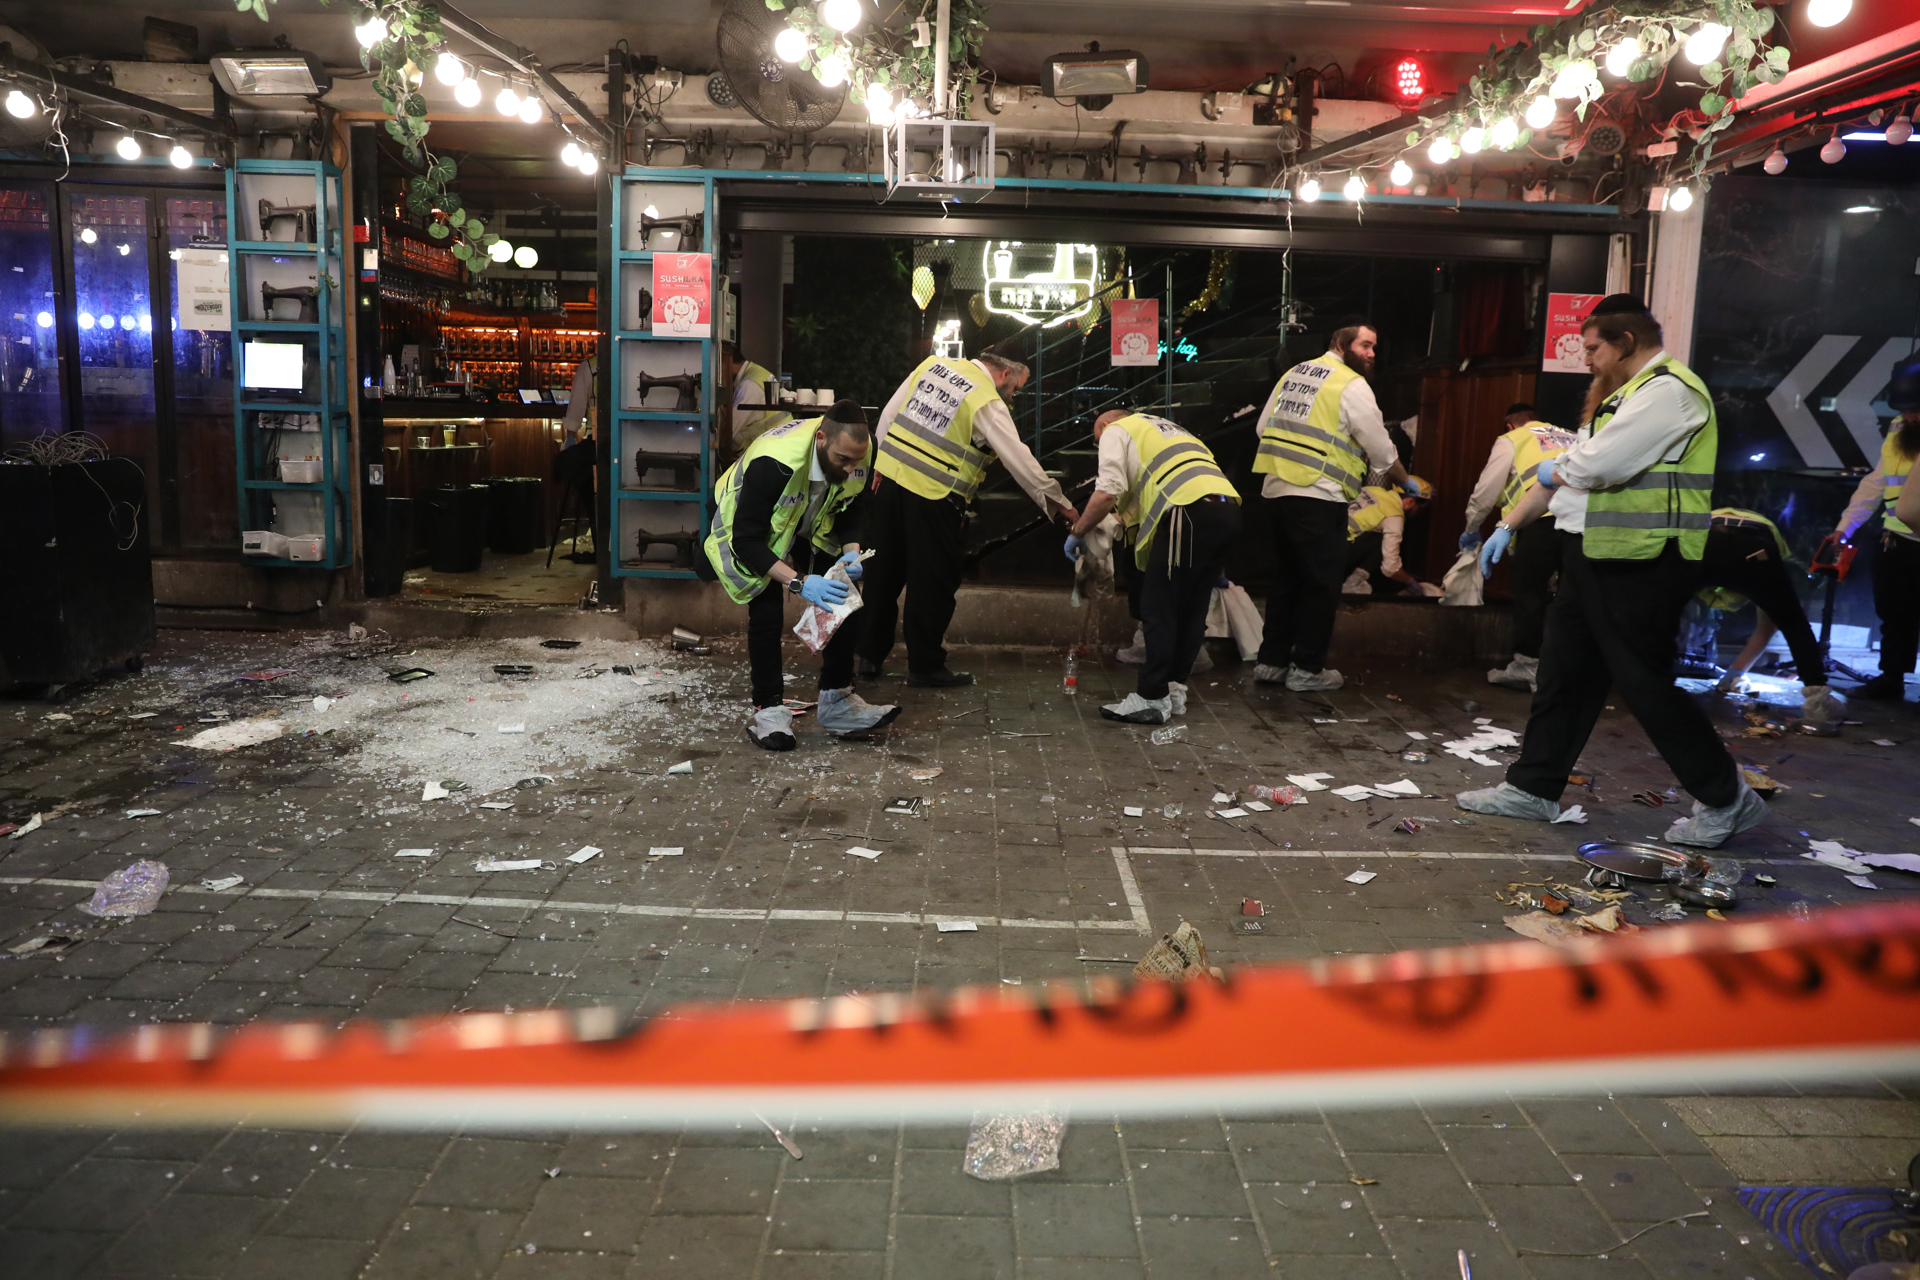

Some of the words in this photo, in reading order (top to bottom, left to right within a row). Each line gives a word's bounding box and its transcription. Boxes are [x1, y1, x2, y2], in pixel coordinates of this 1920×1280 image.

[660, 275, 703, 283] SUSHILKA
[1309, 367, 1331, 379] ראש
[949, 374, 973, 393] ראש
